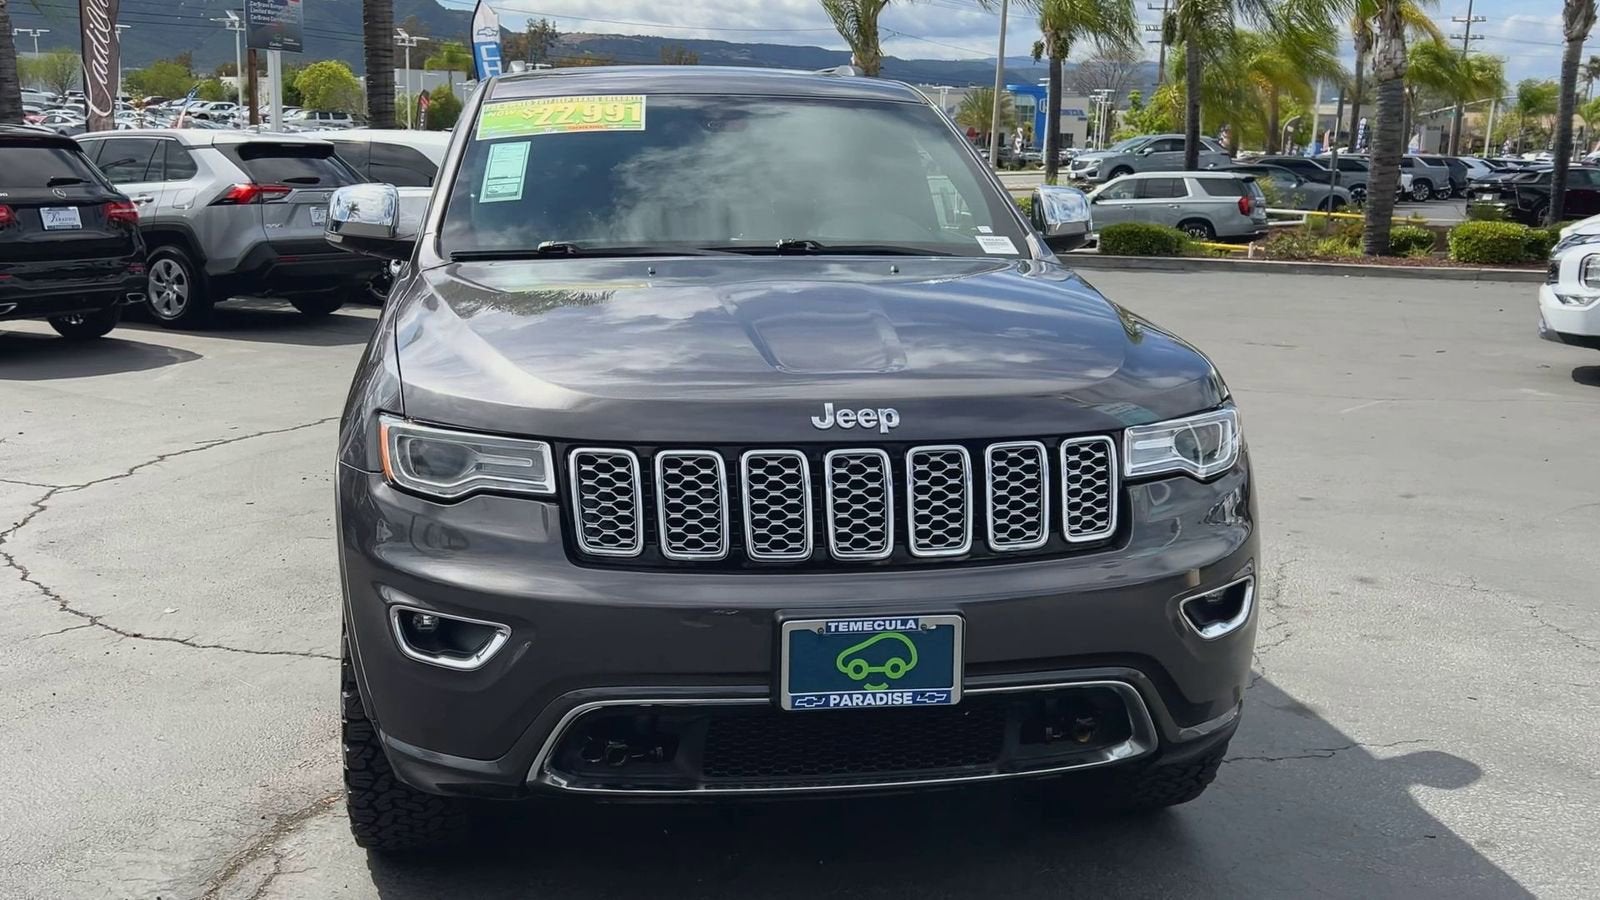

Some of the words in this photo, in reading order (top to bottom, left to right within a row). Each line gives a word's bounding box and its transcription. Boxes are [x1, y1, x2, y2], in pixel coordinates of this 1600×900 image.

[521, 102, 641, 127] $22,991
[811, 402, 900, 433] Jeep
[828, 619, 917, 633] TEMECULA
[829, 692, 913, 707] PARADISE
